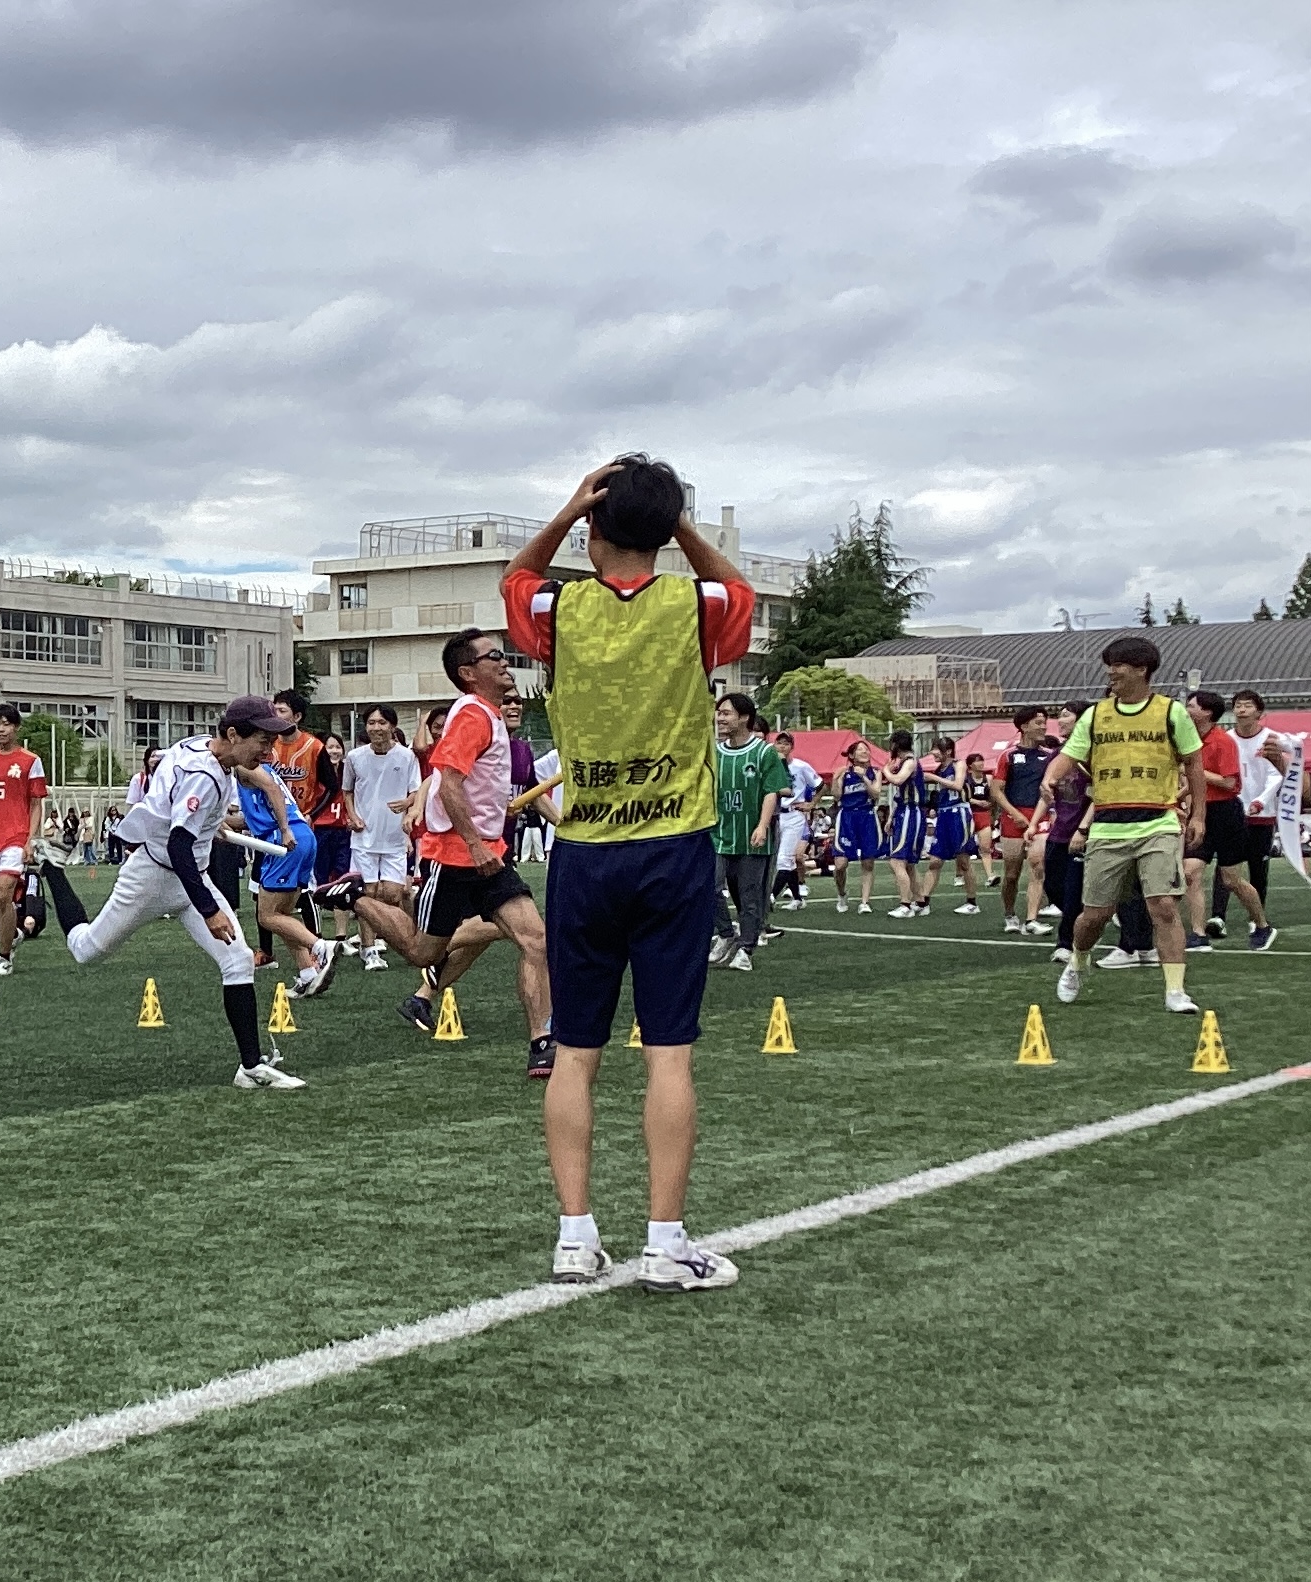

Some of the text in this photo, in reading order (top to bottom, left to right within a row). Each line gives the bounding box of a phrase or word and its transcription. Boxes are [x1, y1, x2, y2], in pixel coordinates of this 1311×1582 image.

[1280, 746, 1303, 822] FINISH
[331, 802, 342, 820] 4
[724, 789, 744, 812] 14
